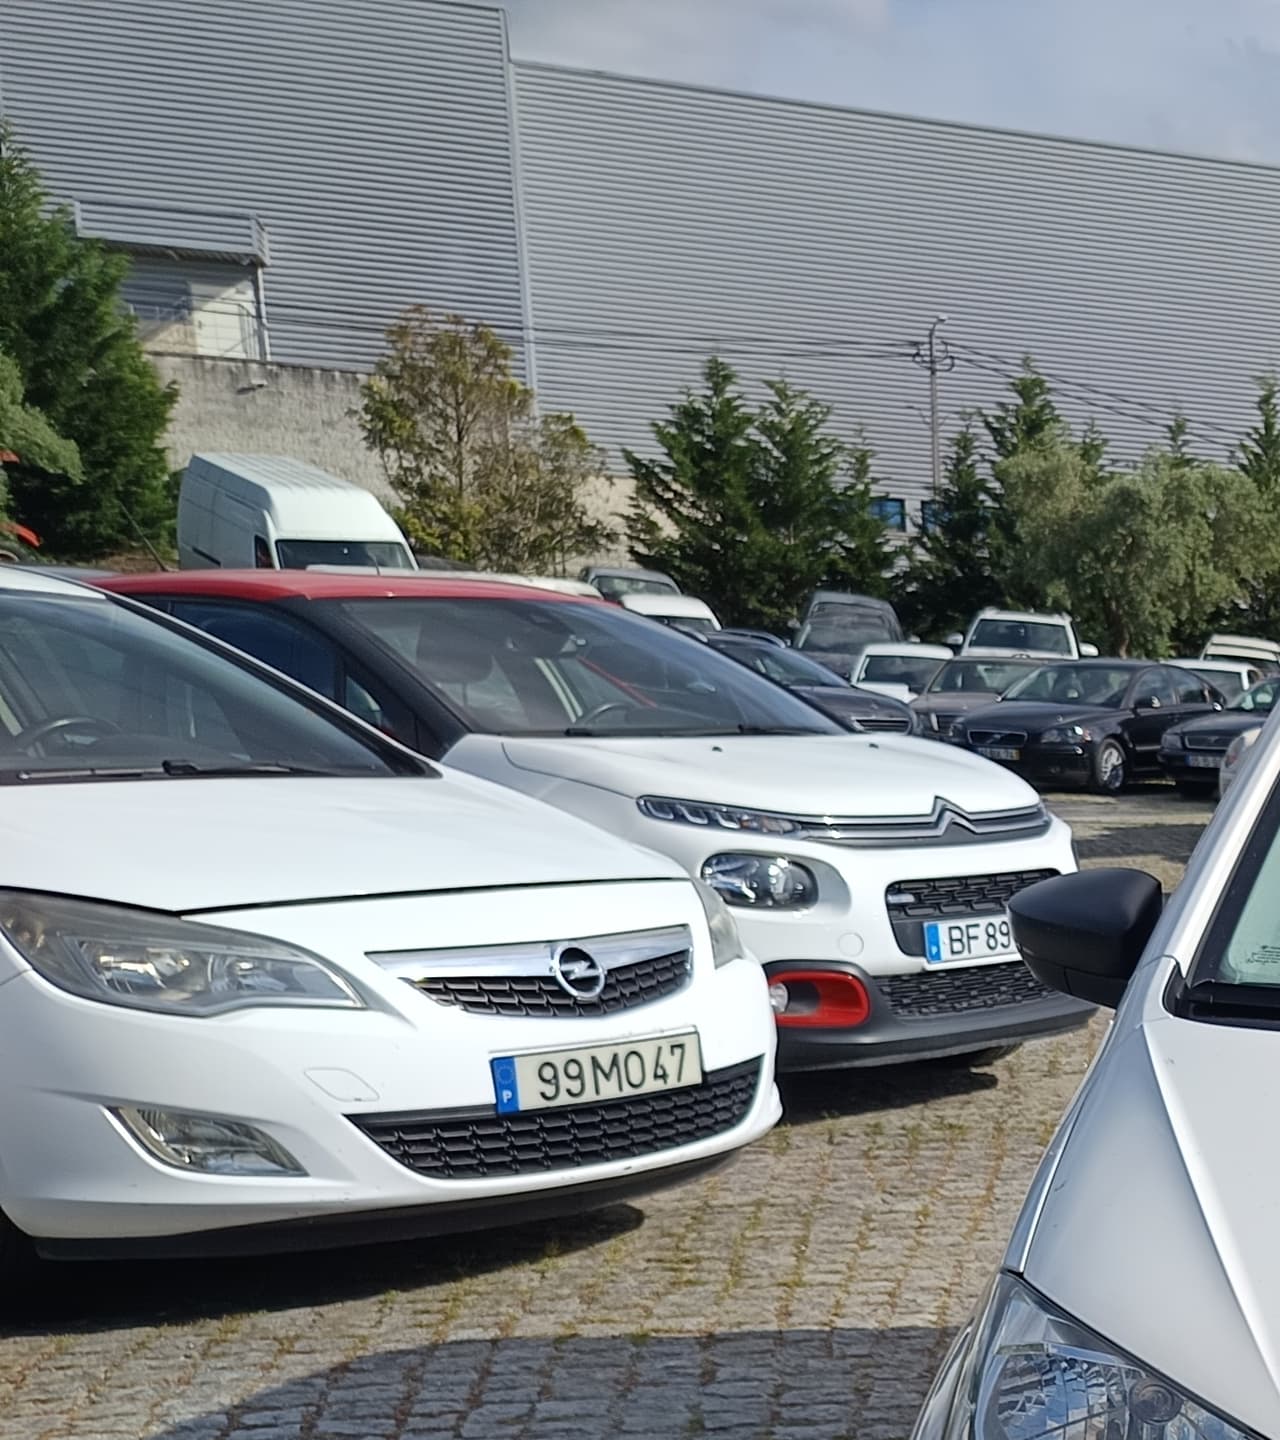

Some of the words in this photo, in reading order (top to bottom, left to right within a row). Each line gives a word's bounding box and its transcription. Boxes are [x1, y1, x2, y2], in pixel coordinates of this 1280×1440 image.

[948, 923, 980, 955] BF
[985, 921, 1011, 950] 89
[537, 1043, 686, 1101] 99MO47
